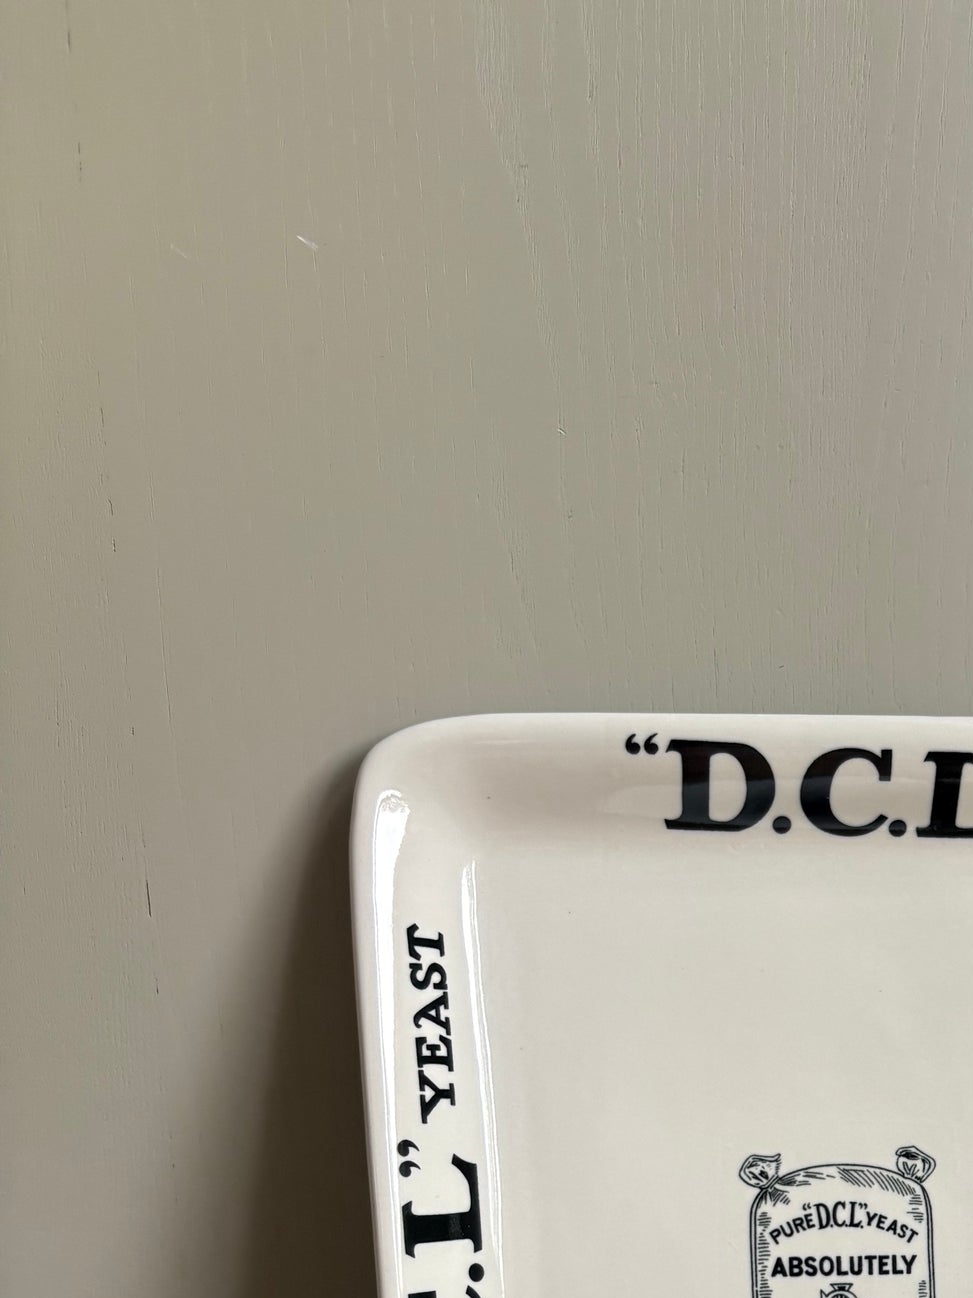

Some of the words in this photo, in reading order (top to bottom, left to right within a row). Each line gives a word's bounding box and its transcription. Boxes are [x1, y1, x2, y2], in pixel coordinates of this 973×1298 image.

[406, 923, 456, 1124] YEAST
[769, 1212, 816, 1244] PURE
[865, 1211, 918, 1243] YEAST
[771, 1254, 917, 1277] ABSOLUTELY
